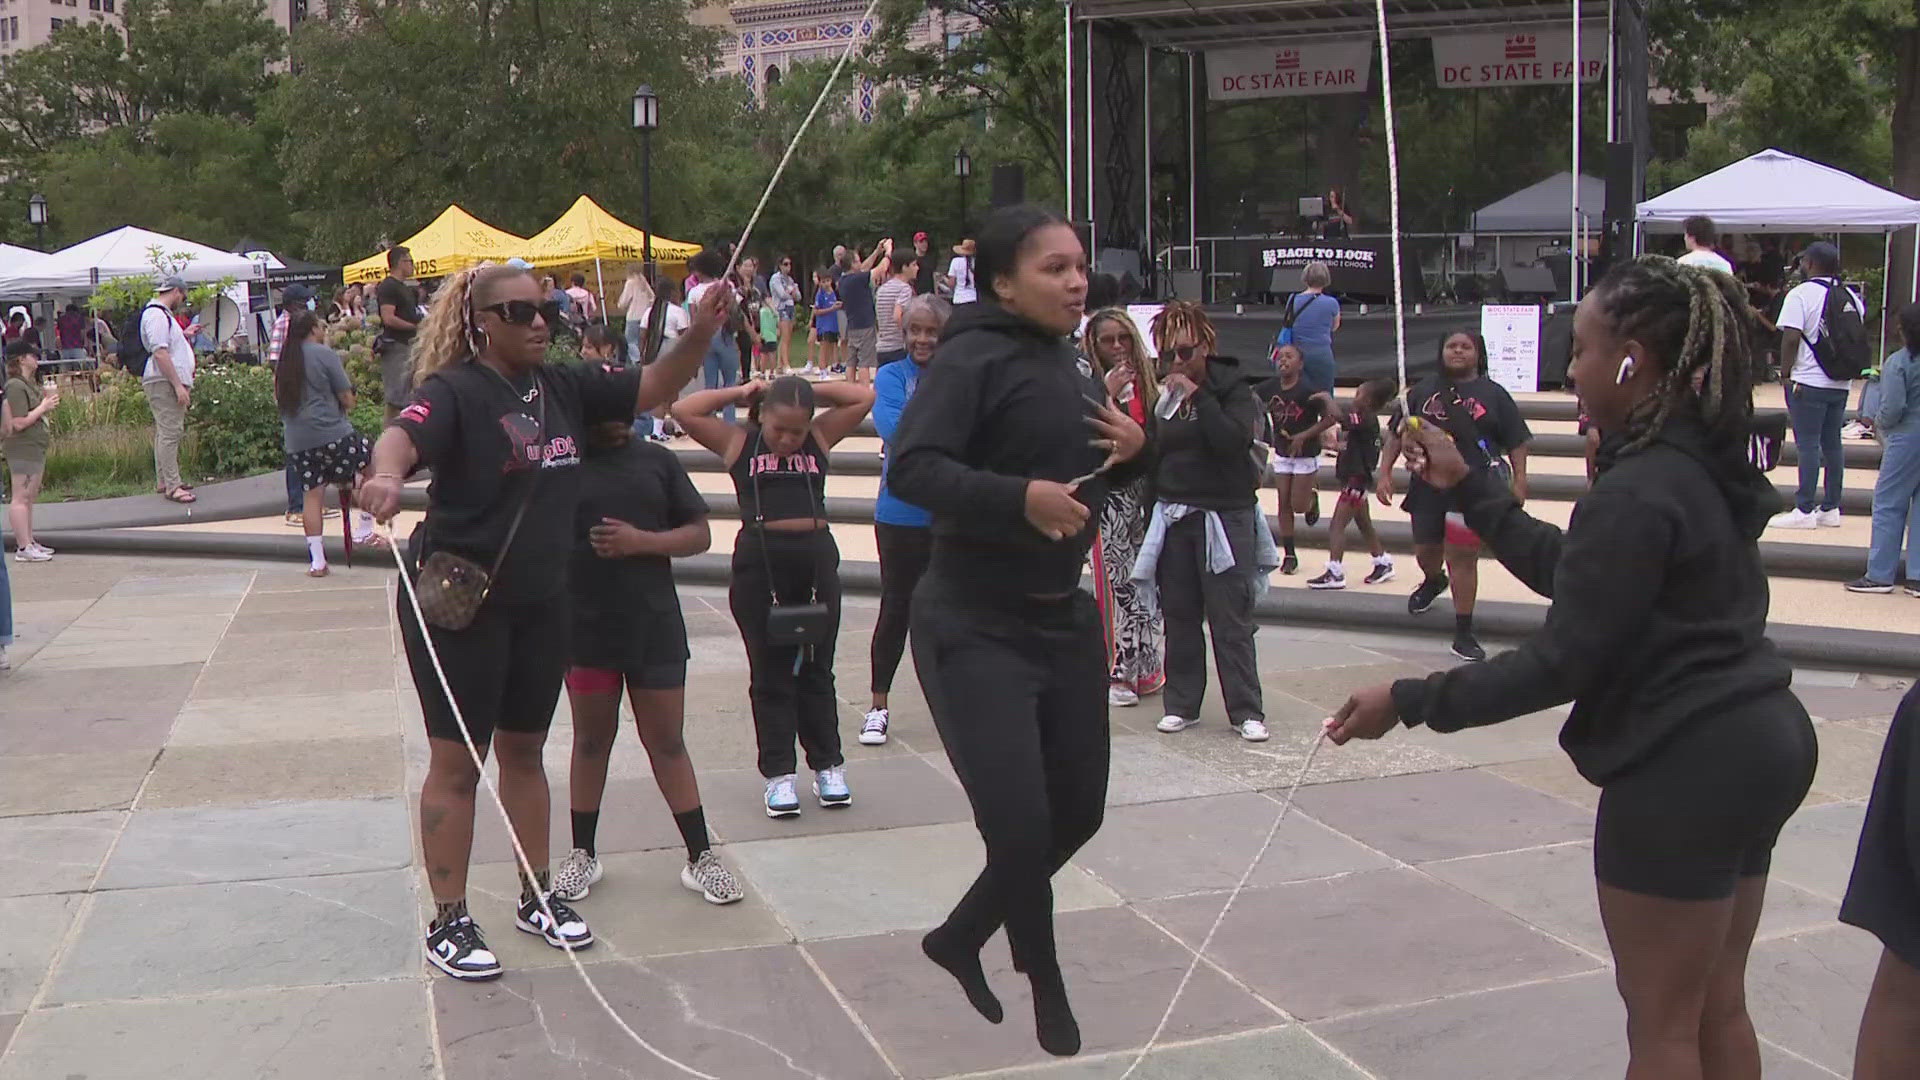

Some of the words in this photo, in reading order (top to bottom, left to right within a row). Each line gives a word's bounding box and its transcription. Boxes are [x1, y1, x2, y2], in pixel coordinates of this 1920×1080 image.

[1223, 74, 1246, 92] DC
[1251, 71, 1308, 89] STATE
[1314, 68, 1356, 86] FAIR
[1443, 66, 1472, 83] DC
[1480, 63, 1542, 81] STATE
[615, 244, 638, 258] THE
[1277, 248, 1314, 258] BACH
[1315, 248, 1334, 258] TO
[359, 266, 381, 280] THE
